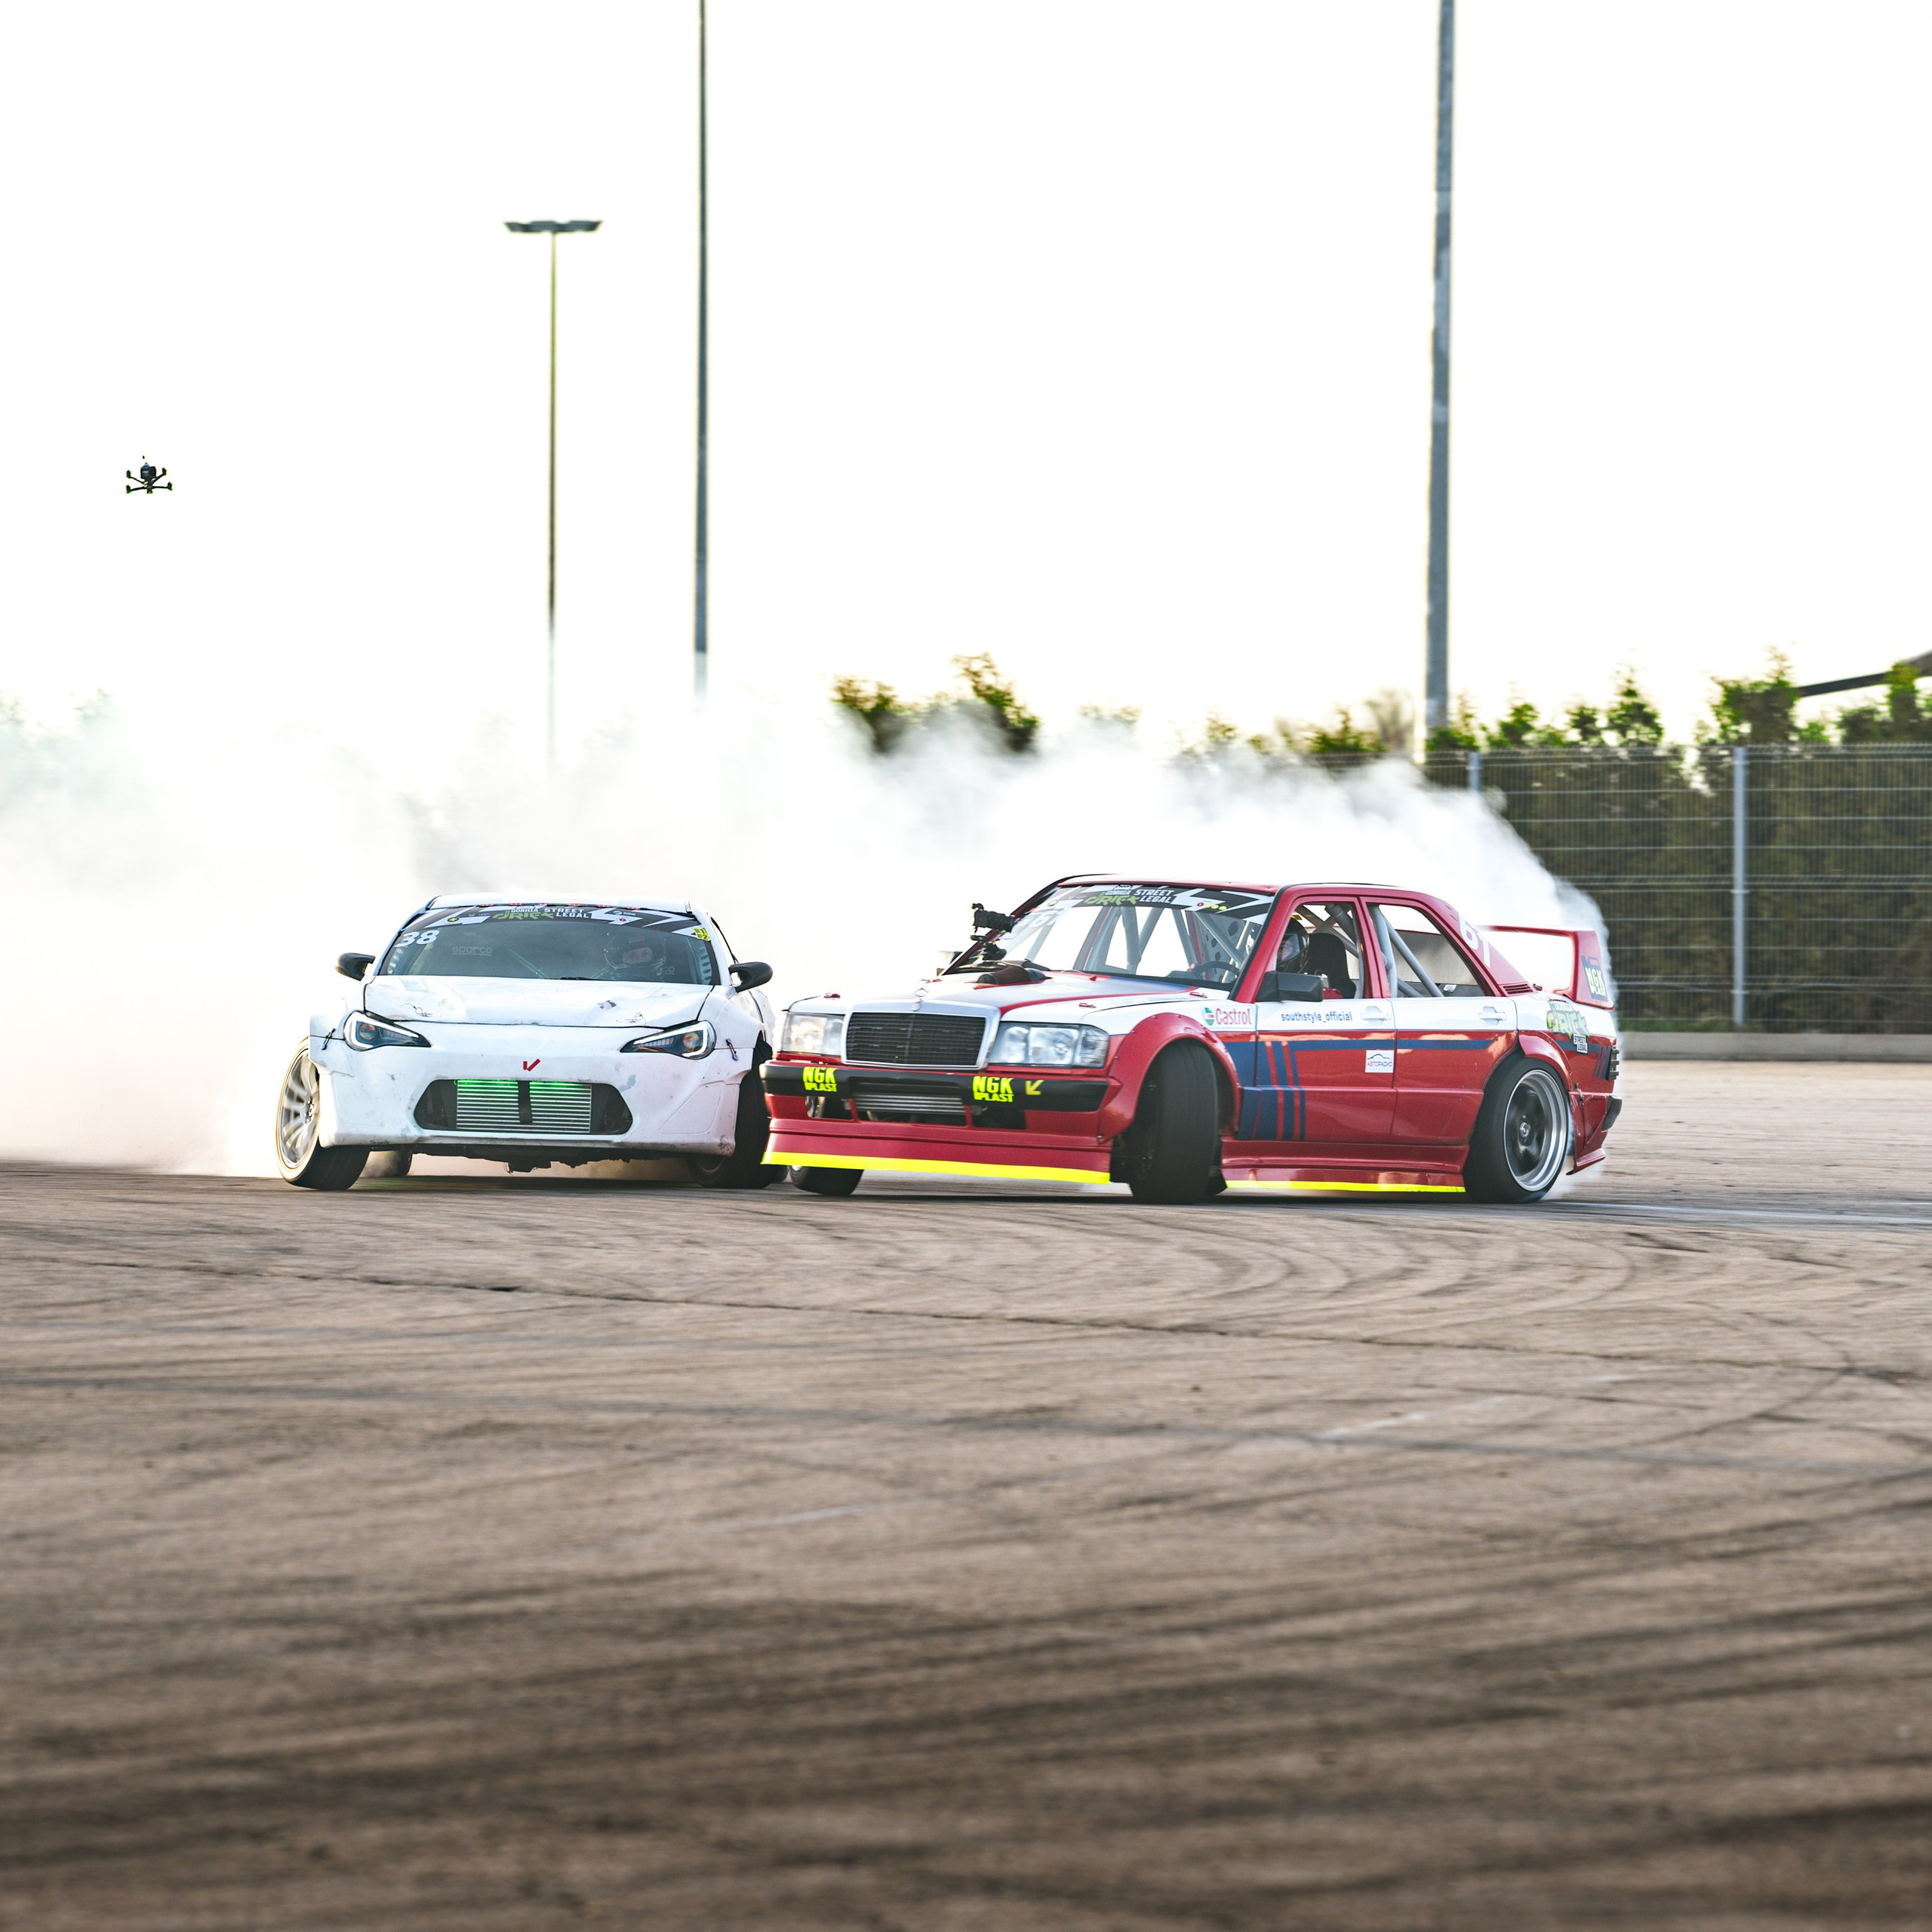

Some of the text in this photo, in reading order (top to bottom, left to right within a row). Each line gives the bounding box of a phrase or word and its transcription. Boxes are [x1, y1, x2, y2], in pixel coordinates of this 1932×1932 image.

[394, 929, 440, 948] 38
[1458, 912, 1491, 968] 61
[452, 946, 493, 955] sparco
[1584, 967, 1606, 989] NGK
[1215, 1008, 1252, 1025] Castrol
[1281, 1011, 1352, 1023] southstyle_official
[803, 1066, 838, 1084] NGK
[972, 1075, 1014, 1094] NGK
